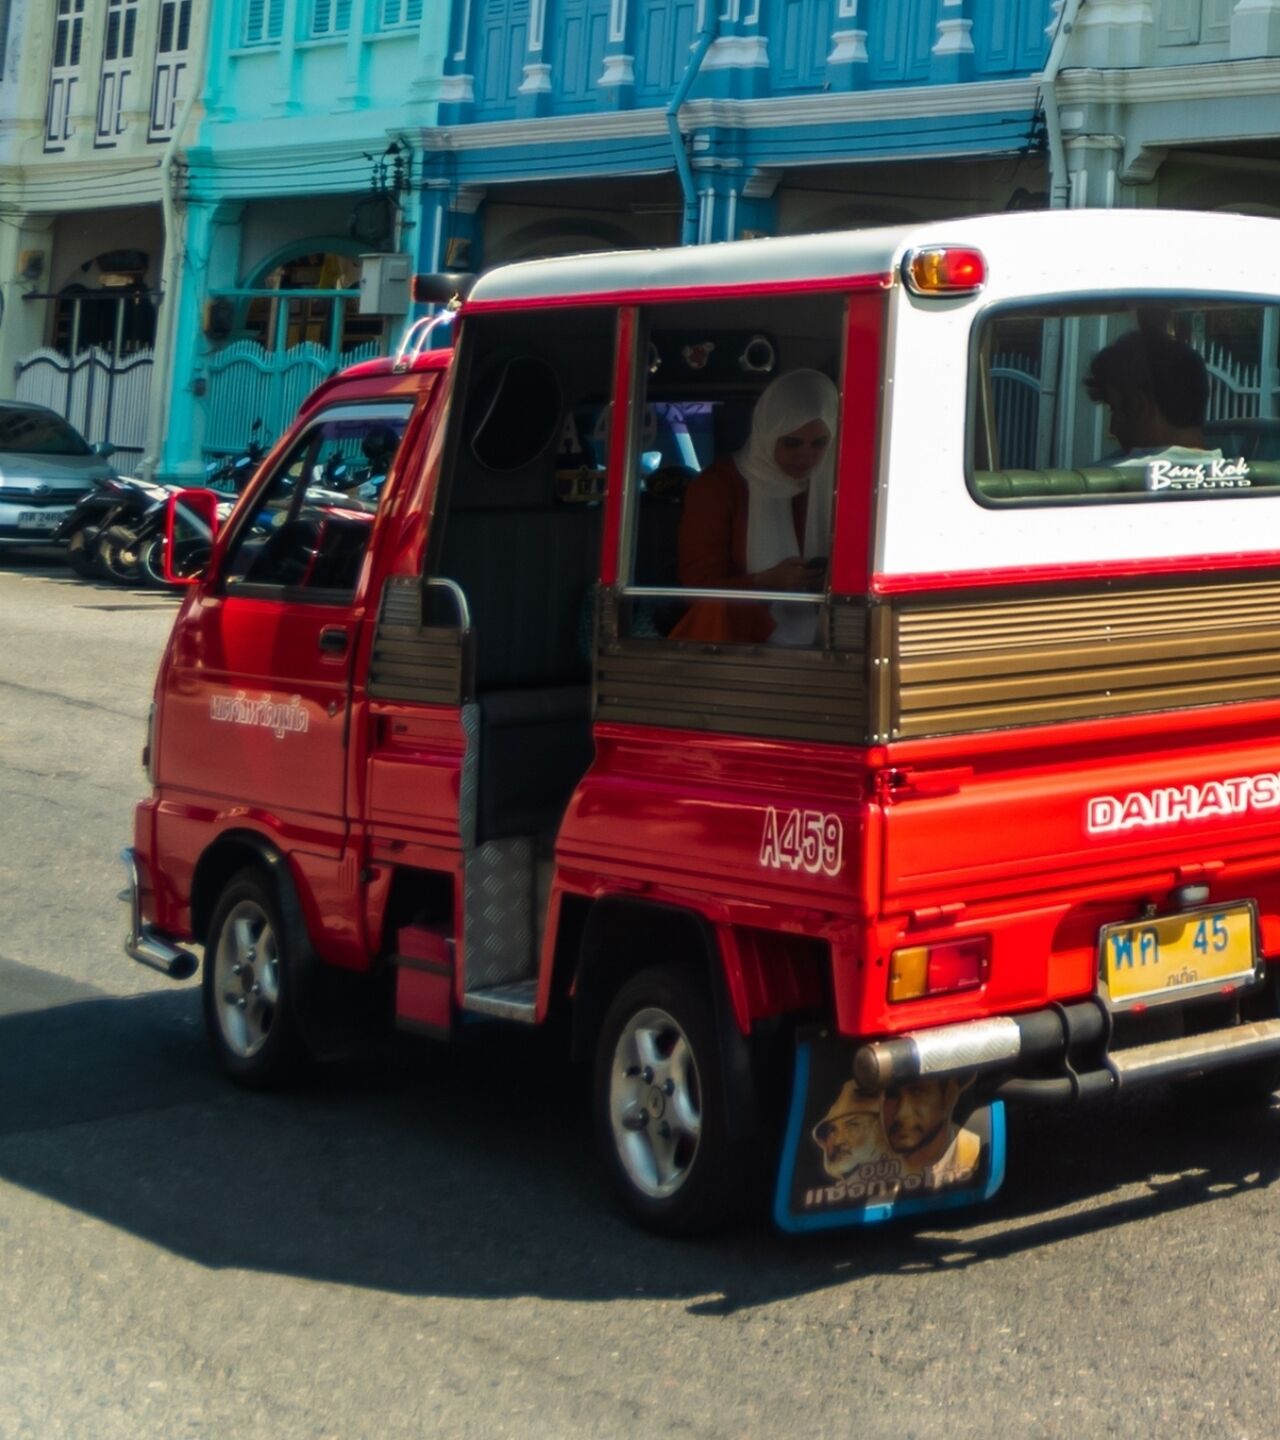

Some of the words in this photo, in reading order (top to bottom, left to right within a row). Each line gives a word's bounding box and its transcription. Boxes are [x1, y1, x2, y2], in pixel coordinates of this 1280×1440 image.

[1149, 459, 1206, 490] Bang
[1171, 480, 1252, 489] SOUND
[759, 806, 844, 876] A459
[1192, 912, 1229, 954] 45
